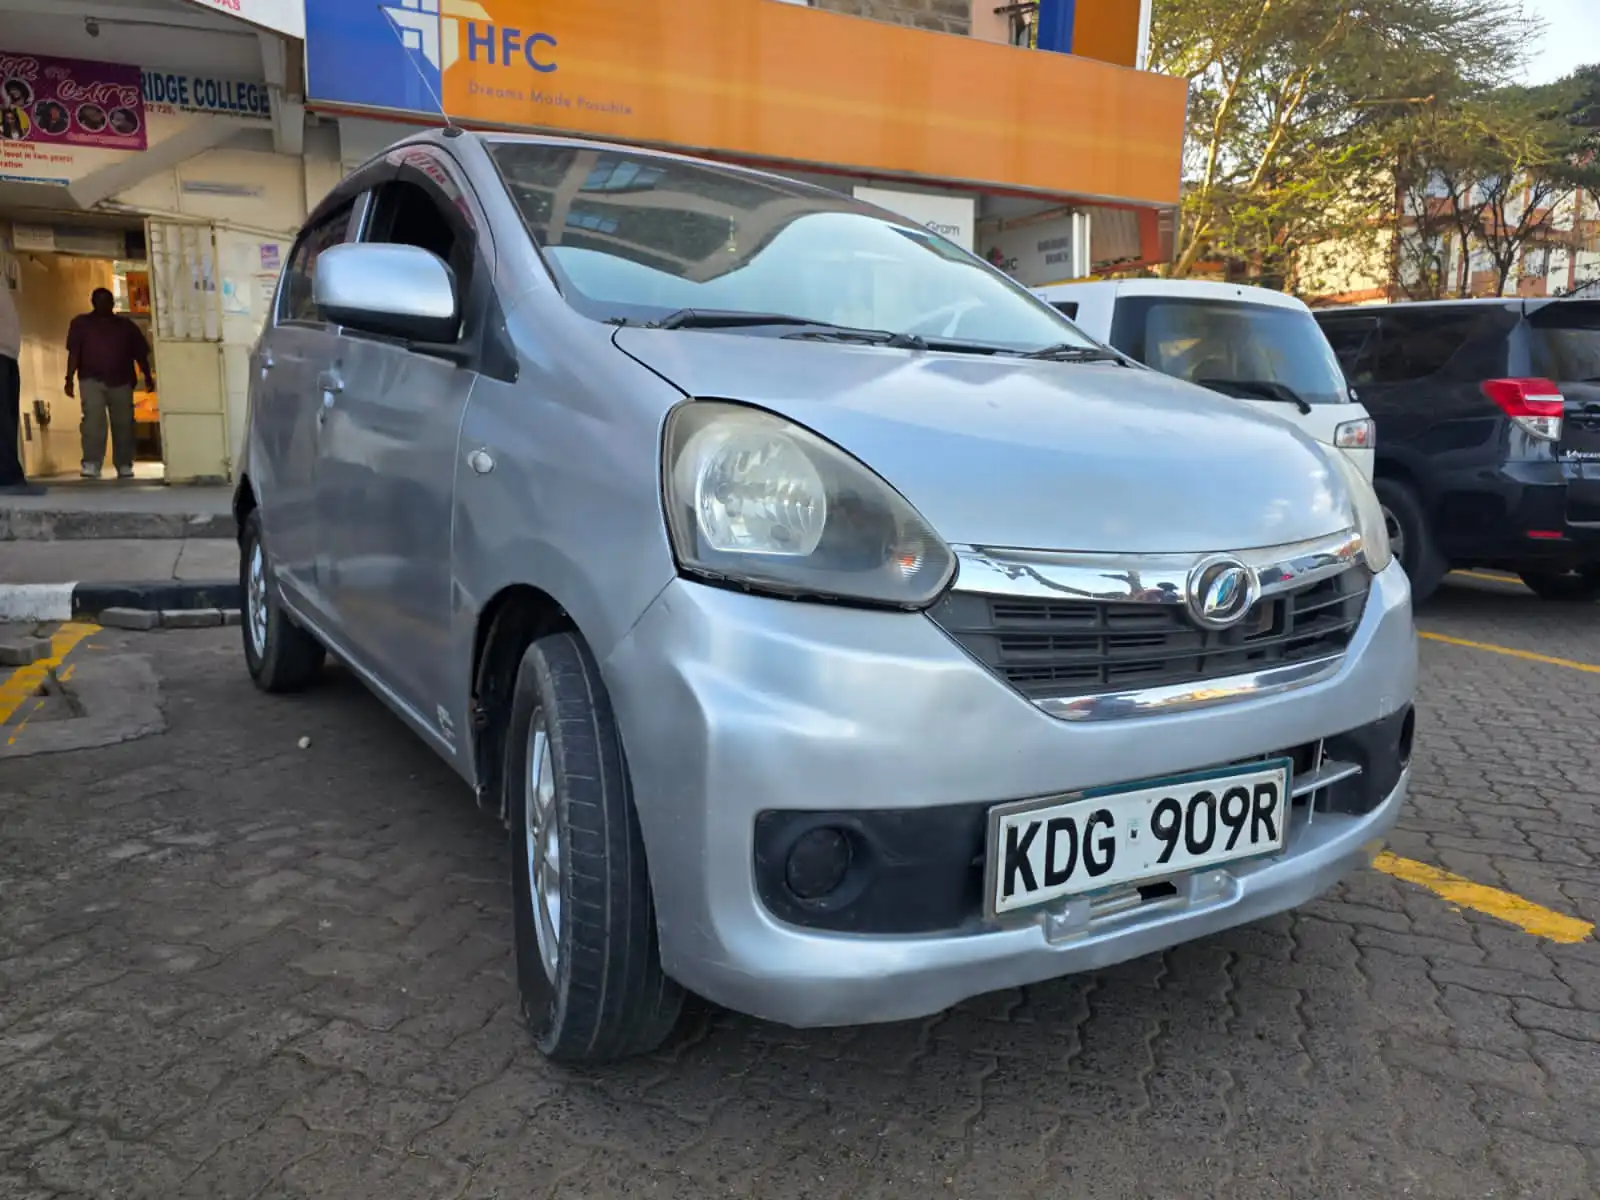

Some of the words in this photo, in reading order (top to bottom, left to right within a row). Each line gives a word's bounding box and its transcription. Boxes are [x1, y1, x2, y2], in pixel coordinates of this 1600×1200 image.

[467, 22, 558, 73] HFC
[193, 77, 270, 114] COLLEGE
[468, 79, 524, 101] Dreams
[530, 88, 571, 108] Made
[1002, 808, 1116, 897] KDG
[1150, 782, 1279, 864] 909R
